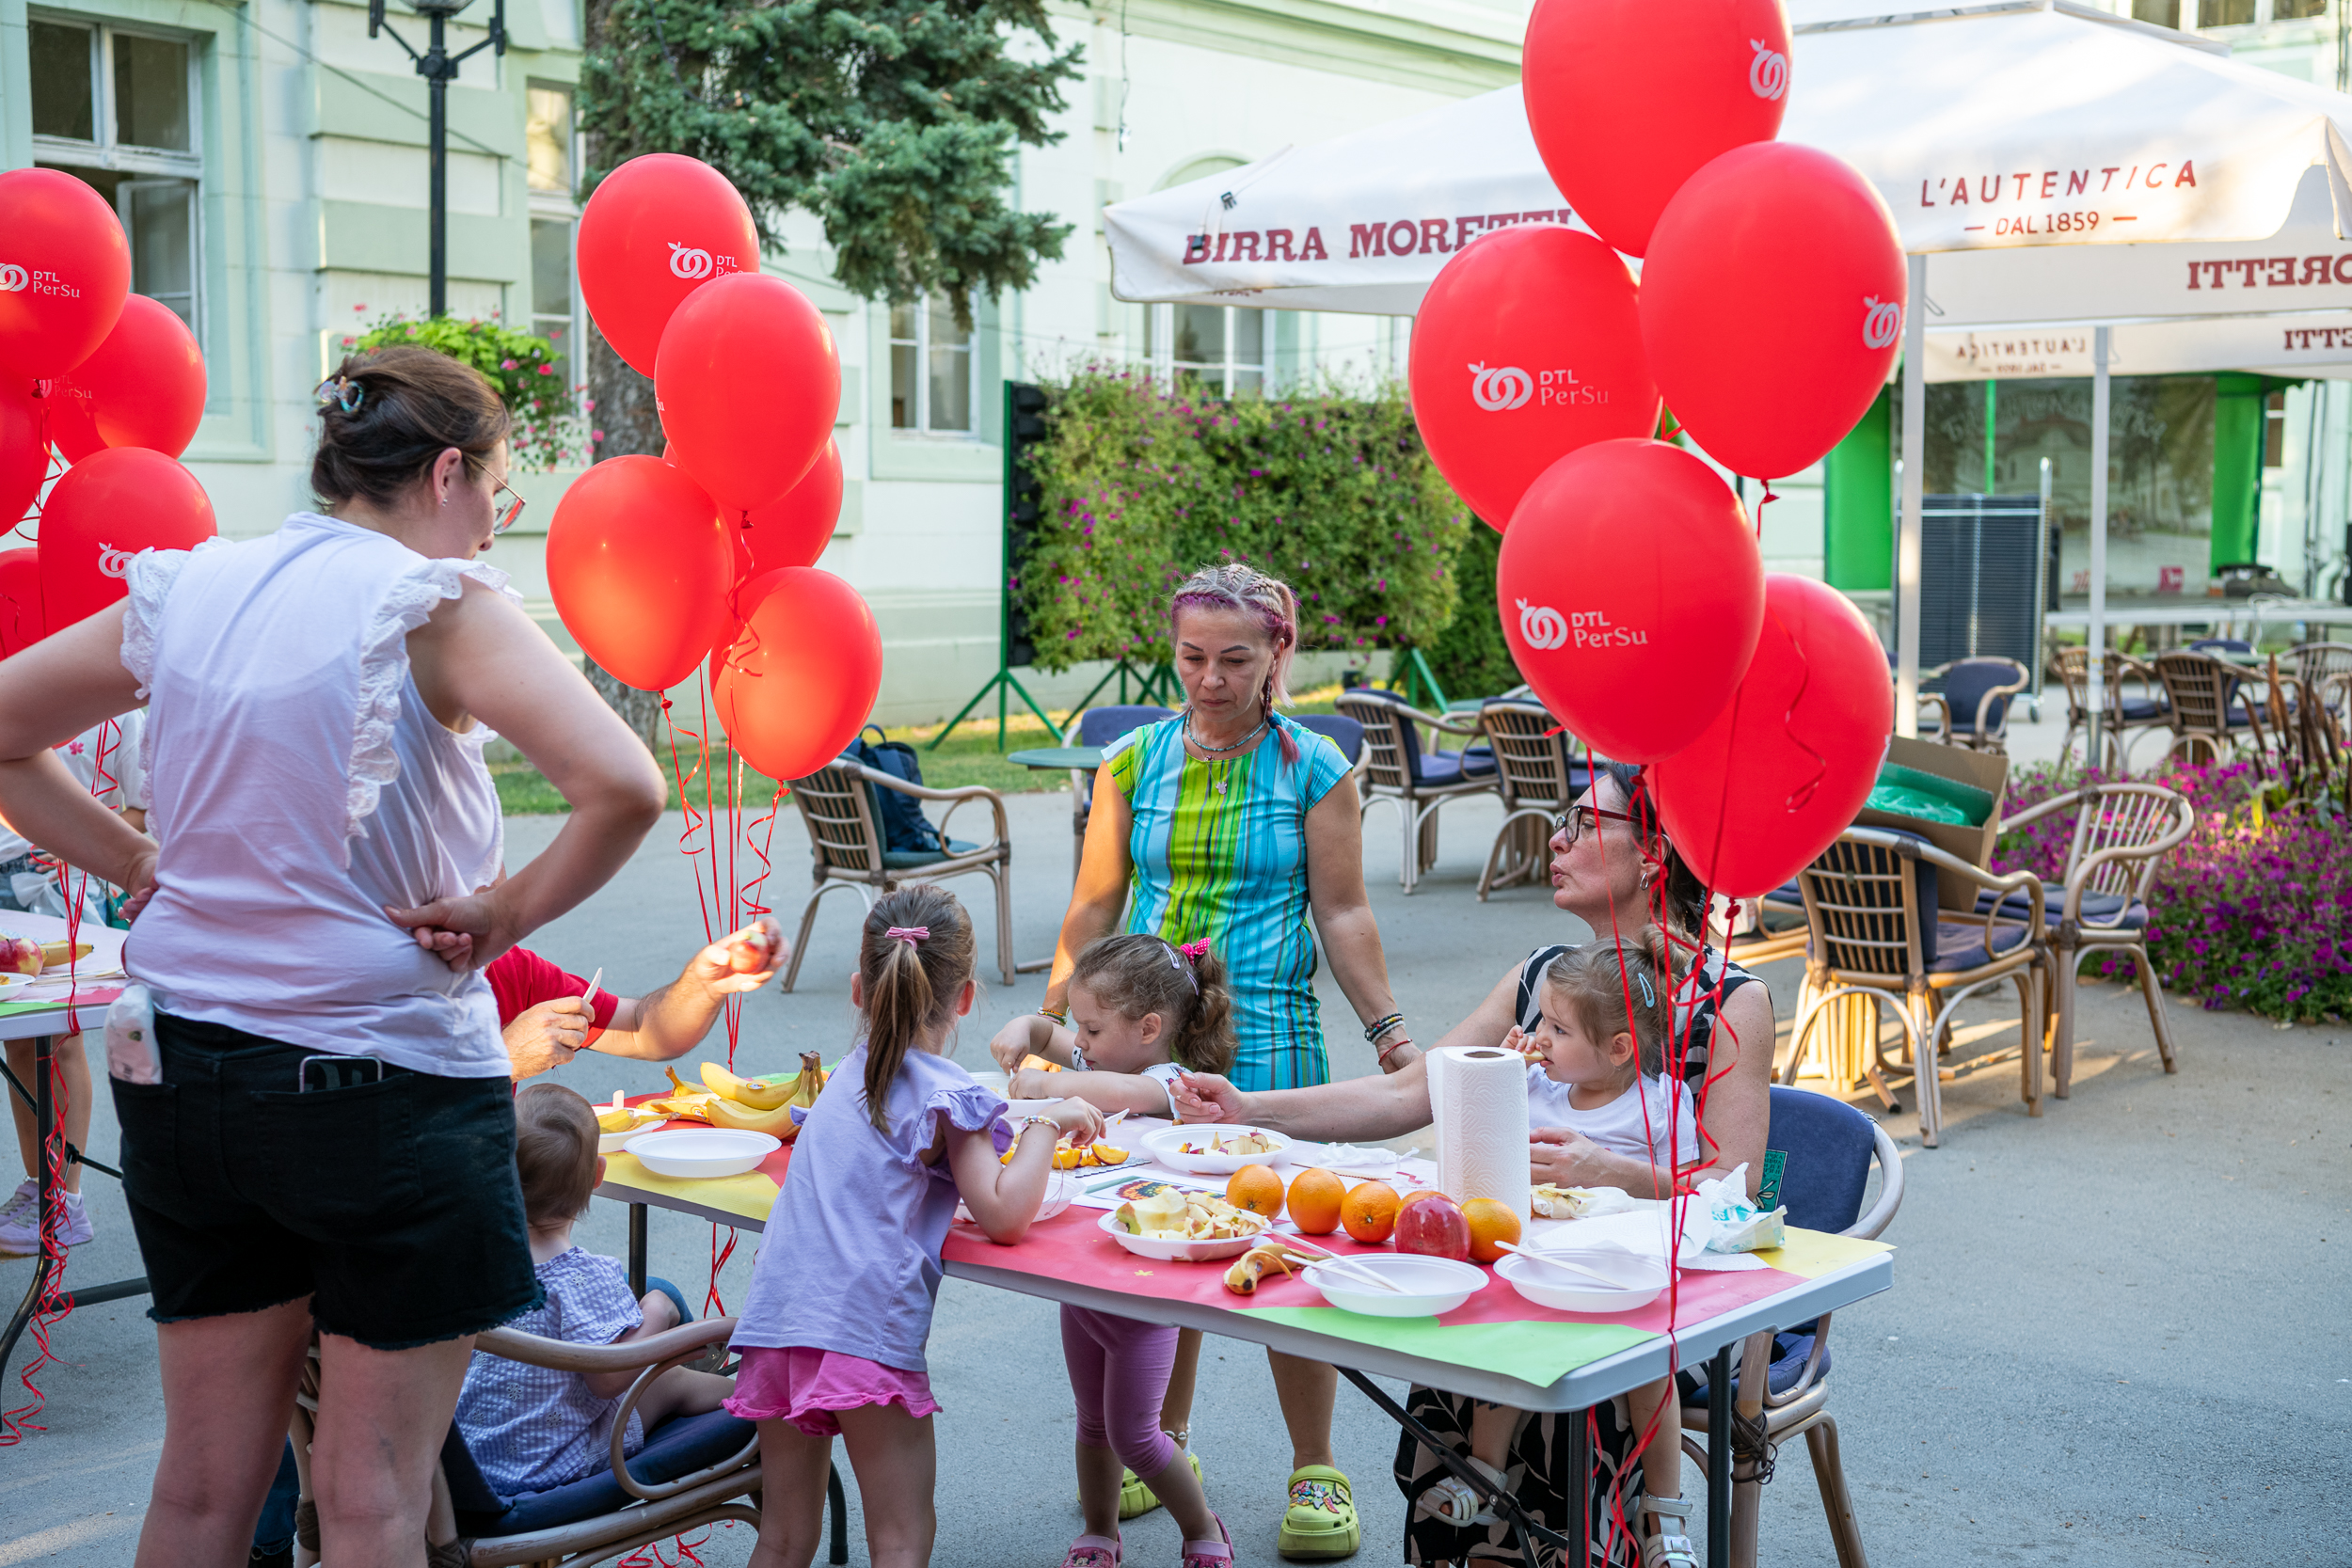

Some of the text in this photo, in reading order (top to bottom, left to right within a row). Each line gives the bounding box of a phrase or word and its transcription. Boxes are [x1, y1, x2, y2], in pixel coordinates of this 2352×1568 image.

[1921, 160, 2196, 207] L'AUTENTICA
[1995, 211, 2100, 235] DAL 1859
[1183, 227, 1328, 264] BIRRA
[717, 255, 738, 268] DTL
[33, 270, 60, 282] DTL
[33, 281, 80, 298] PerSu
[1539, 369, 1579, 385] DTL
[55, 385, 92, 399] PerSu
[1540, 386, 1609, 406] PerSu
[1571, 610, 1611, 627] DTL
[1573, 626, 1648, 648] PerSu
